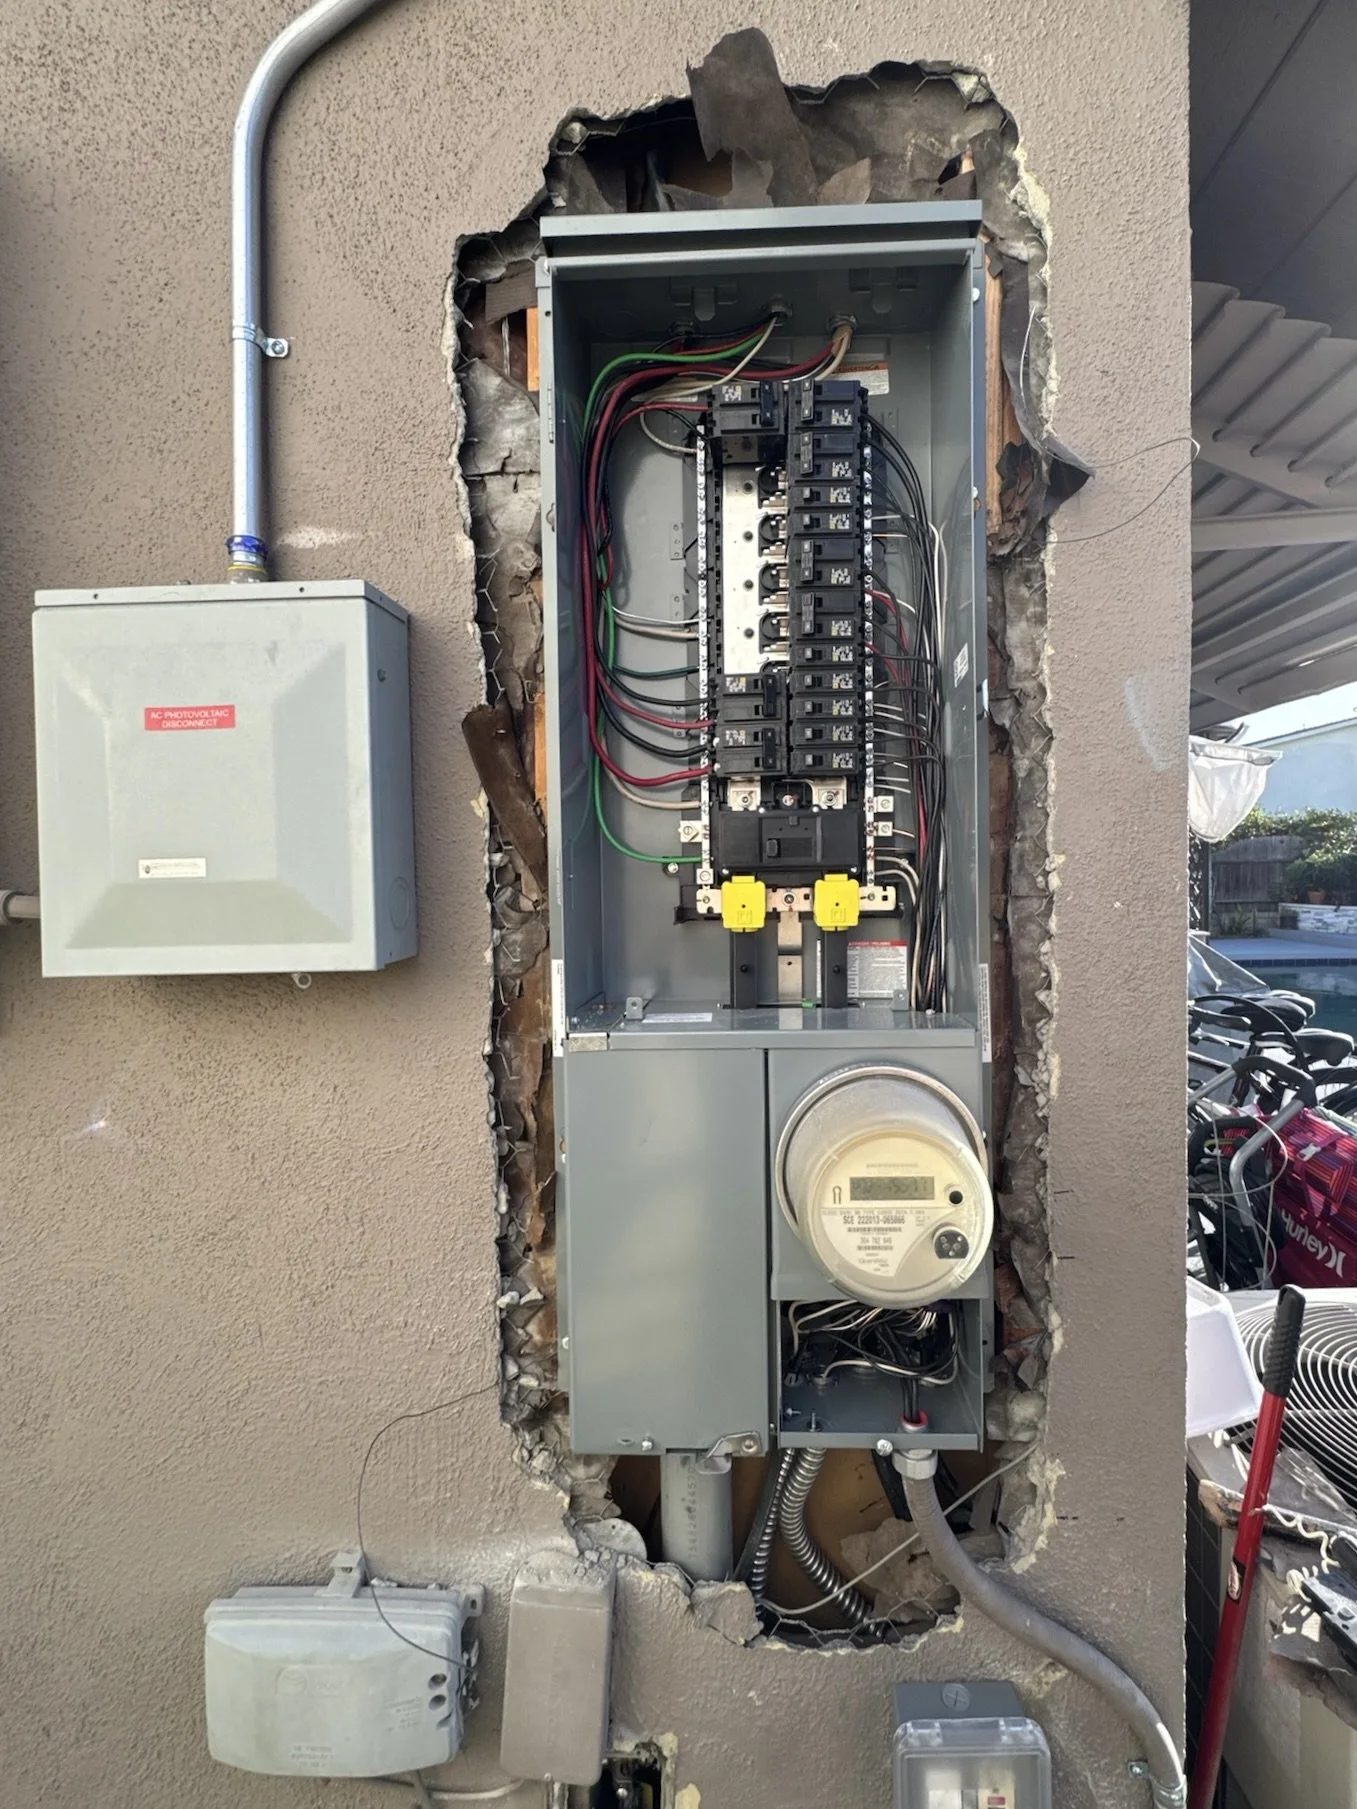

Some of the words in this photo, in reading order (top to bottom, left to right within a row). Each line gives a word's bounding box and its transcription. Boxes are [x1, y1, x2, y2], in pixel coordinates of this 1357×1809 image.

[151, 711, 164, 720] AC
[164, 708, 230, 719] PHOTOVOLTAIC
[161, 718, 218, 729] DISCONNECT
[1281, 1208, 1329, 1260] Hurley
